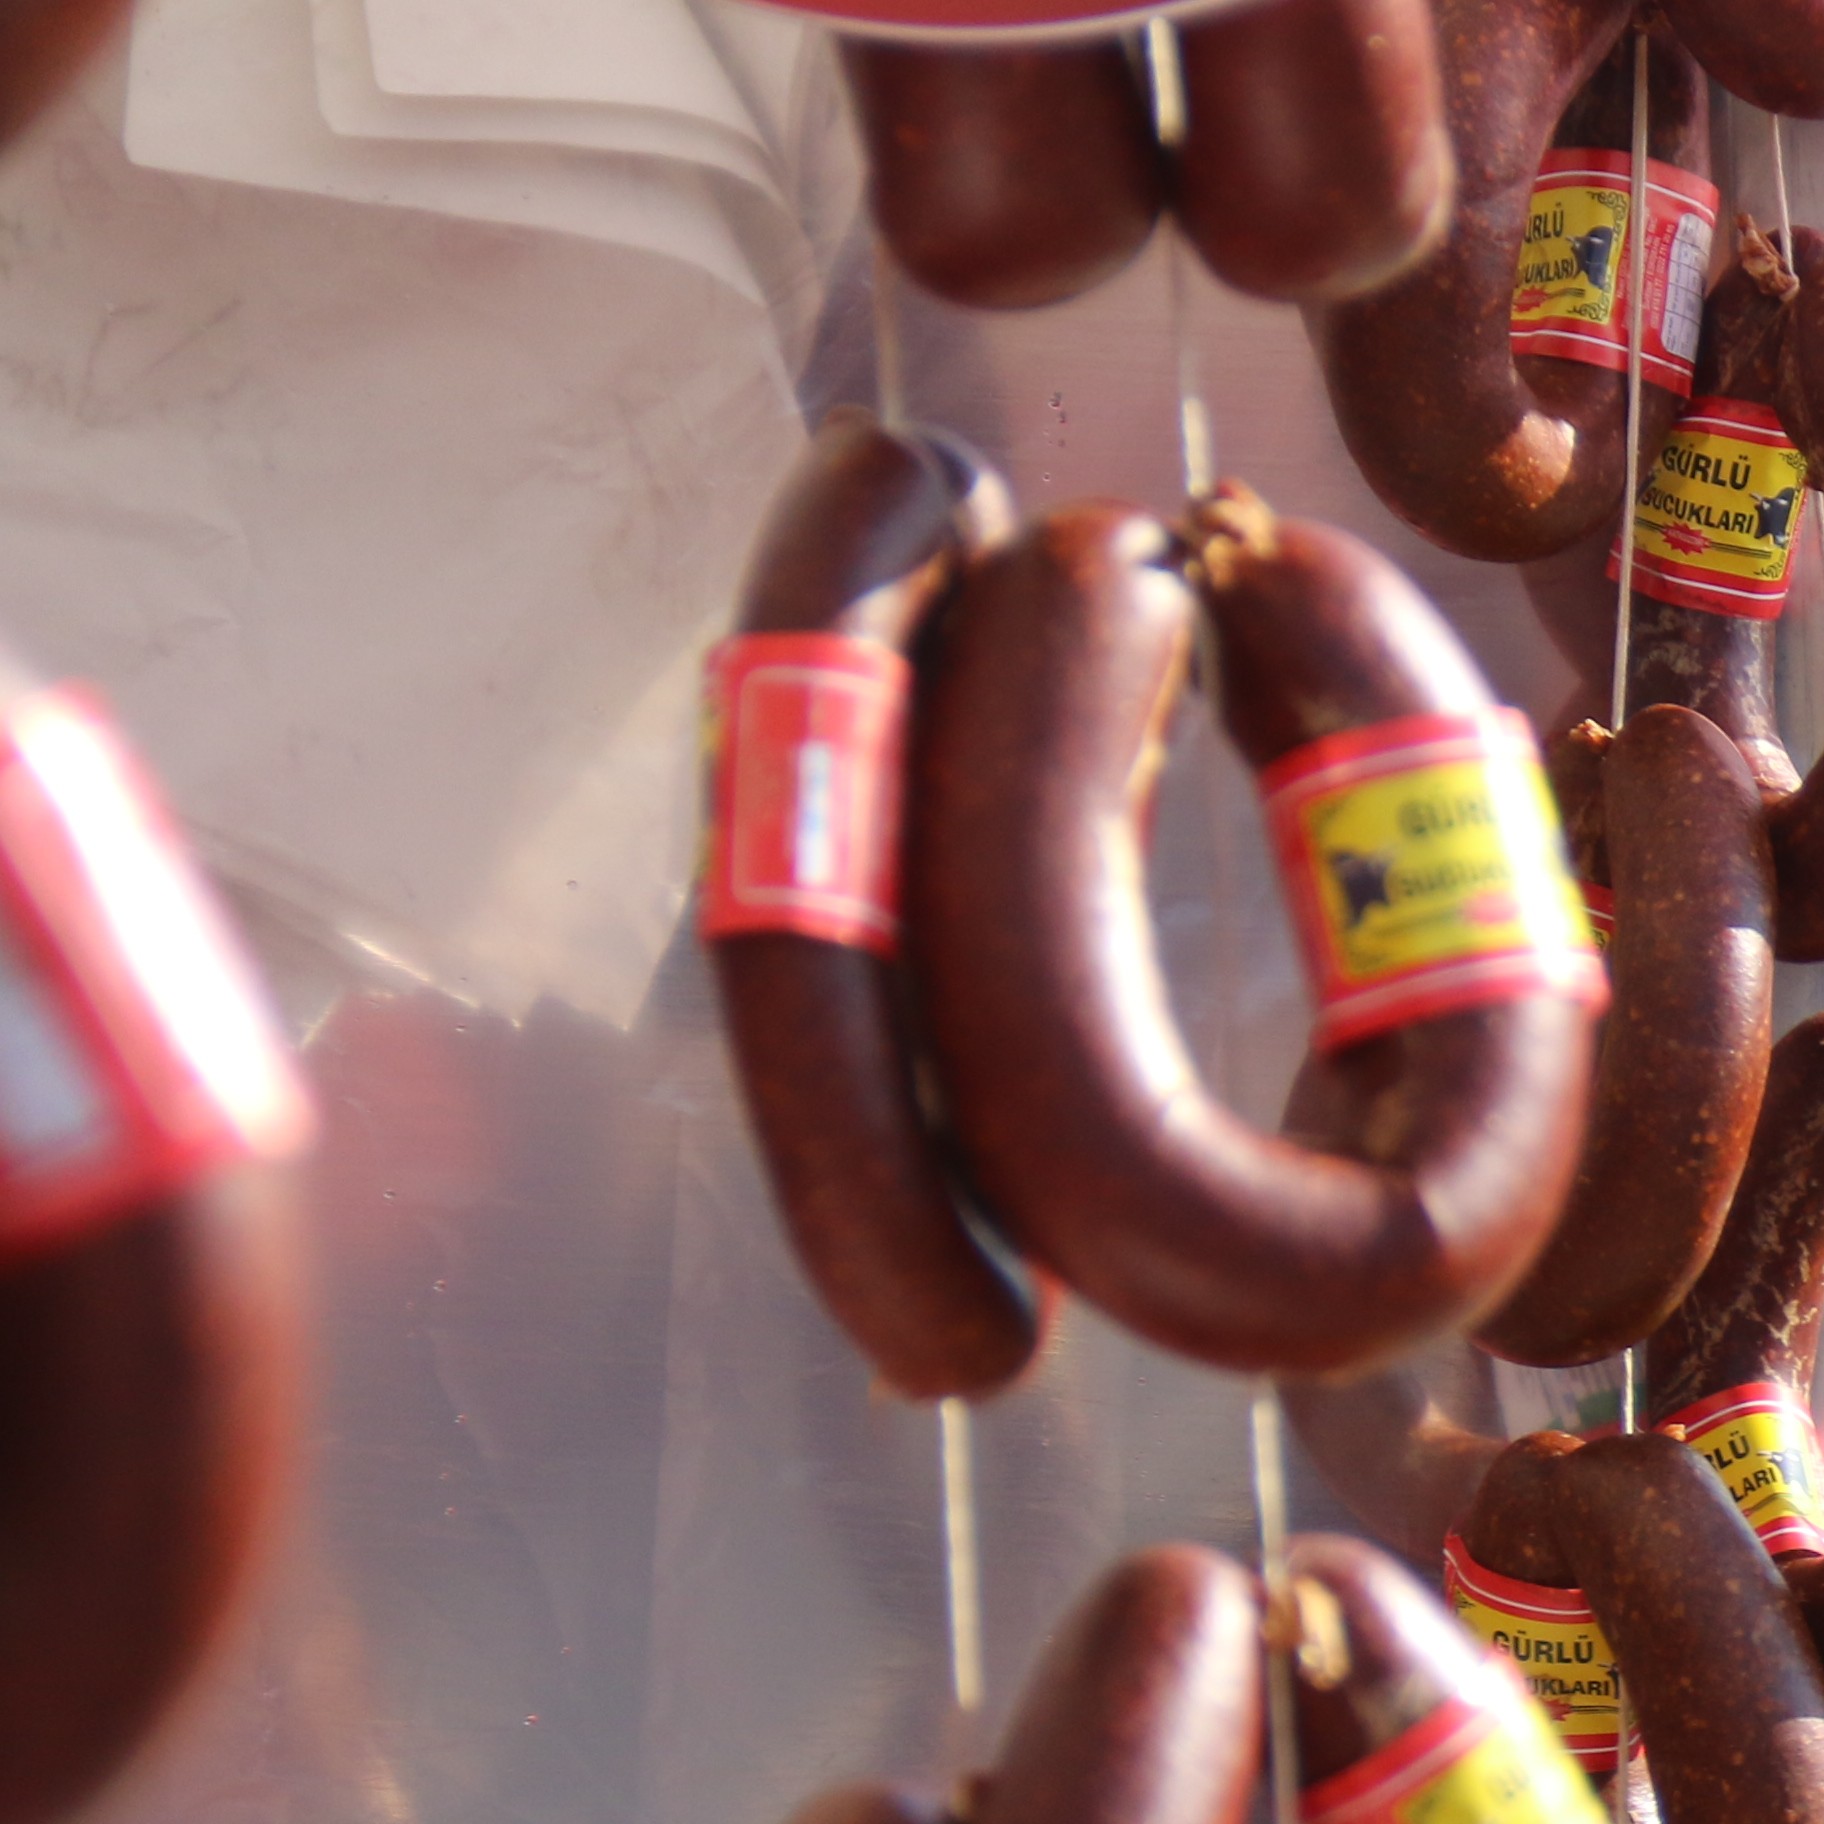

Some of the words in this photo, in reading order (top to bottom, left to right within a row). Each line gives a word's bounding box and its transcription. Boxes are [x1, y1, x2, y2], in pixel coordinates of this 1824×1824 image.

[1662, 443, 1752, 490] GÜRLÜ
[1642, 487, 1755, 534] SUCUKLARI
[1492, 1629, 1594, 1665] GÜRLÜ
